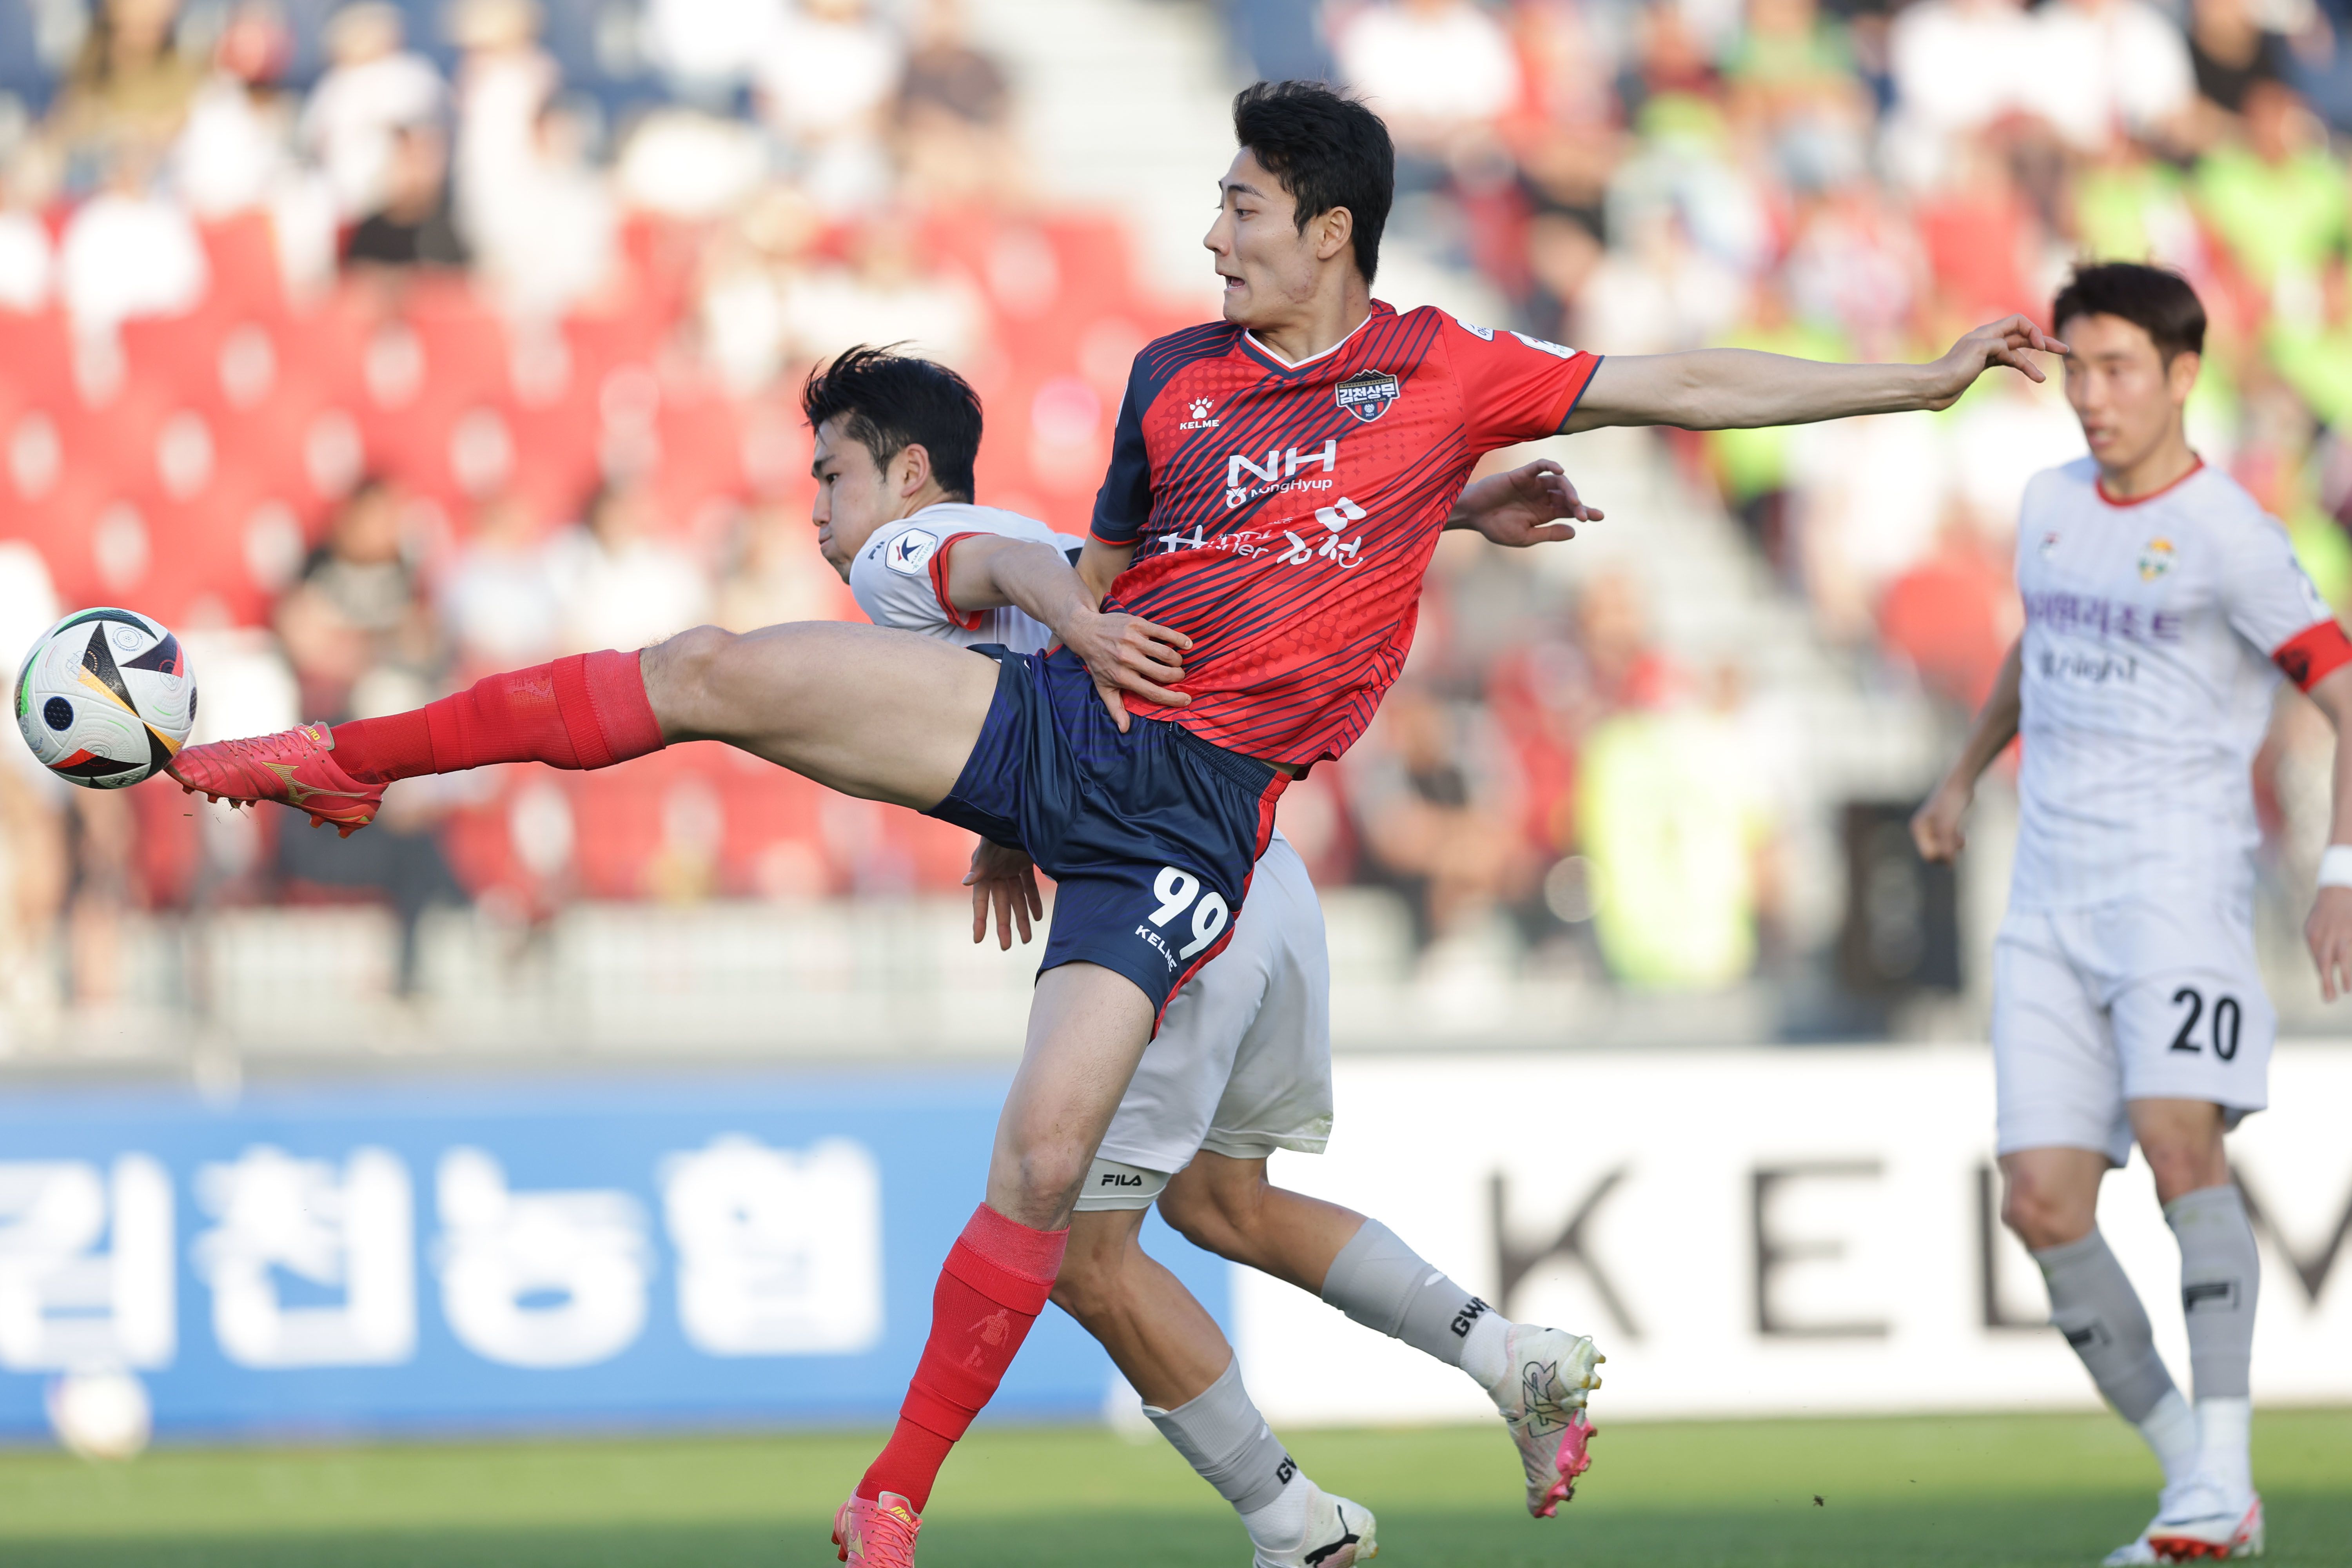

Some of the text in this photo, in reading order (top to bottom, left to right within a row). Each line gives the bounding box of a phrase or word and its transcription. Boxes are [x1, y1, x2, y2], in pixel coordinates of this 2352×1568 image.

[1339, 383, 1396, 405] 김천상무
[1179, 419, 1220, 430] KELME
[1227, 439, 1336, 487] NH
[1148, 866, 1228, 960] 99
[1135, 925, 1177, 972] KELME
[2169, 986, 2241, 1062] 20
[1101, 1174, 1142, 1187] FILA
